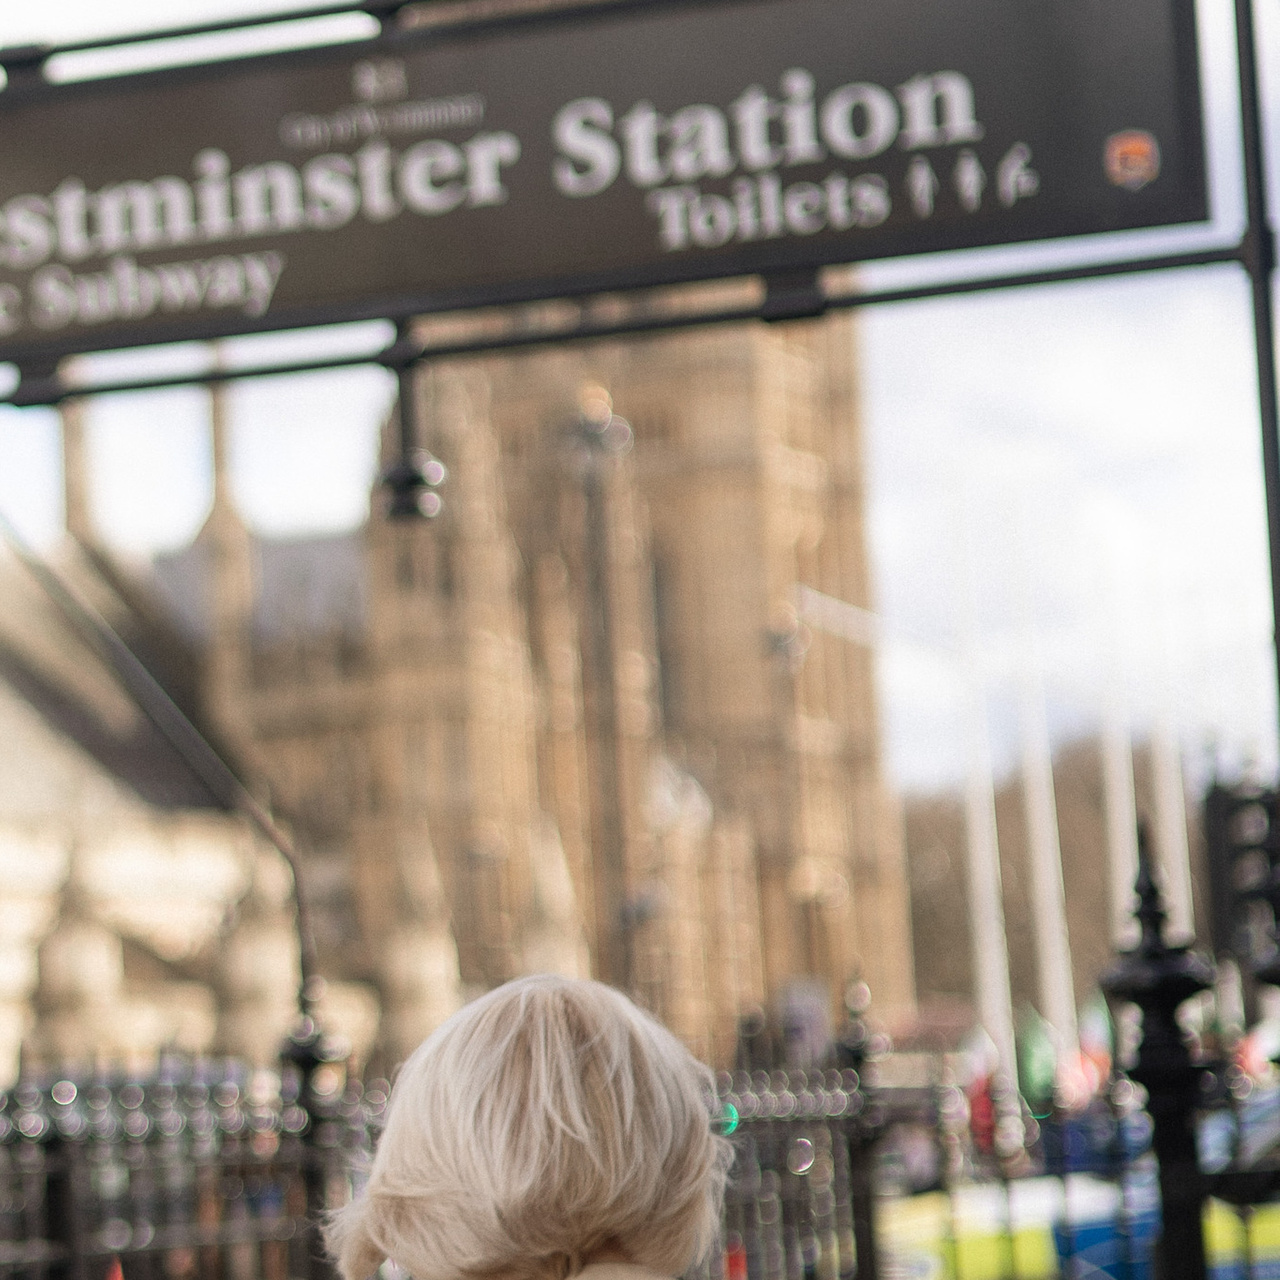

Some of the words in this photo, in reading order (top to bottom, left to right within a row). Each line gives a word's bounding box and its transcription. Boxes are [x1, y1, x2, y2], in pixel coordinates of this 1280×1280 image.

[553, 68, 982, 199] Station
[648, 171, 892, 253] Toilets
[29, 250, 287, 330] Subway
